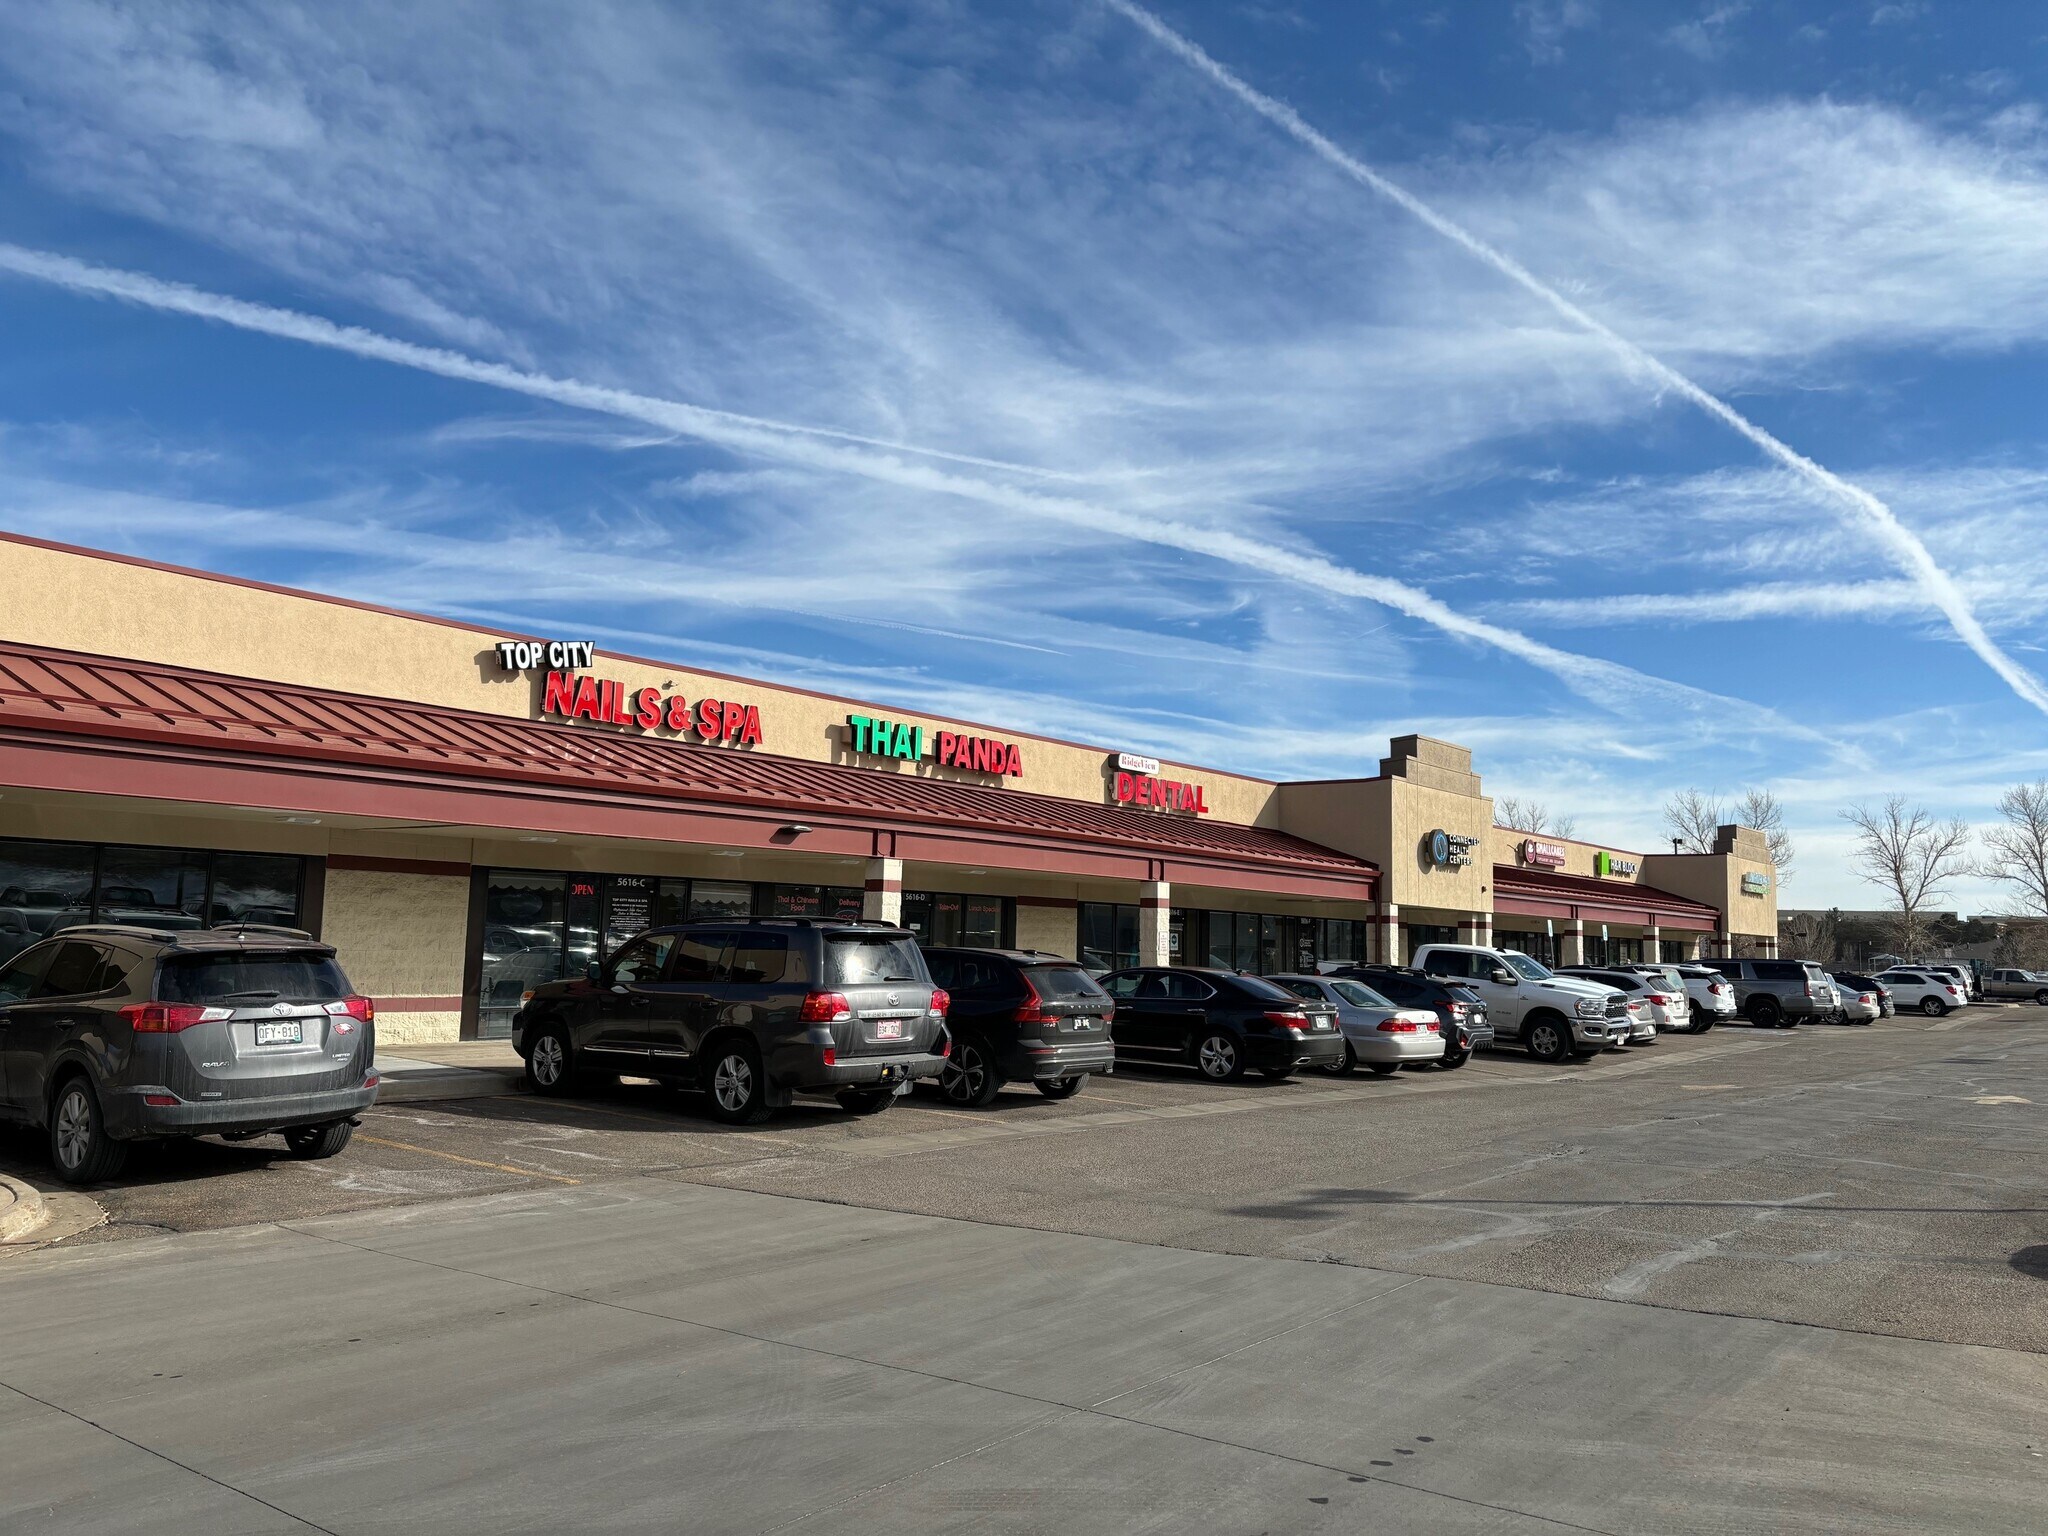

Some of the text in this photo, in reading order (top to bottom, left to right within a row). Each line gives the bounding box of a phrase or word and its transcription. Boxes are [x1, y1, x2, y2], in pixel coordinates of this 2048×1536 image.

[501, 641, 595, 669] TOP CITY
[544, 670, 763, 744] NAILS & SPA
[851, 715, 1023, 777] THAI PANDA
[1121, 755, 1156, 770] RidgeView
[1117, 772, 1208, 813] DENTAL
[1450, 834, 1479, 846] CONNECTED
[1450, 845, 1468, 855] HEALTH
[1450, 855, 1472, 866] CENTERS
[1611, 859, 1622, 872] H&R
[617, 878, 646, 887] 5616-C
[839, 898, 860, 908] Delivery
[202, 1060, 230, 1068] RAV4
